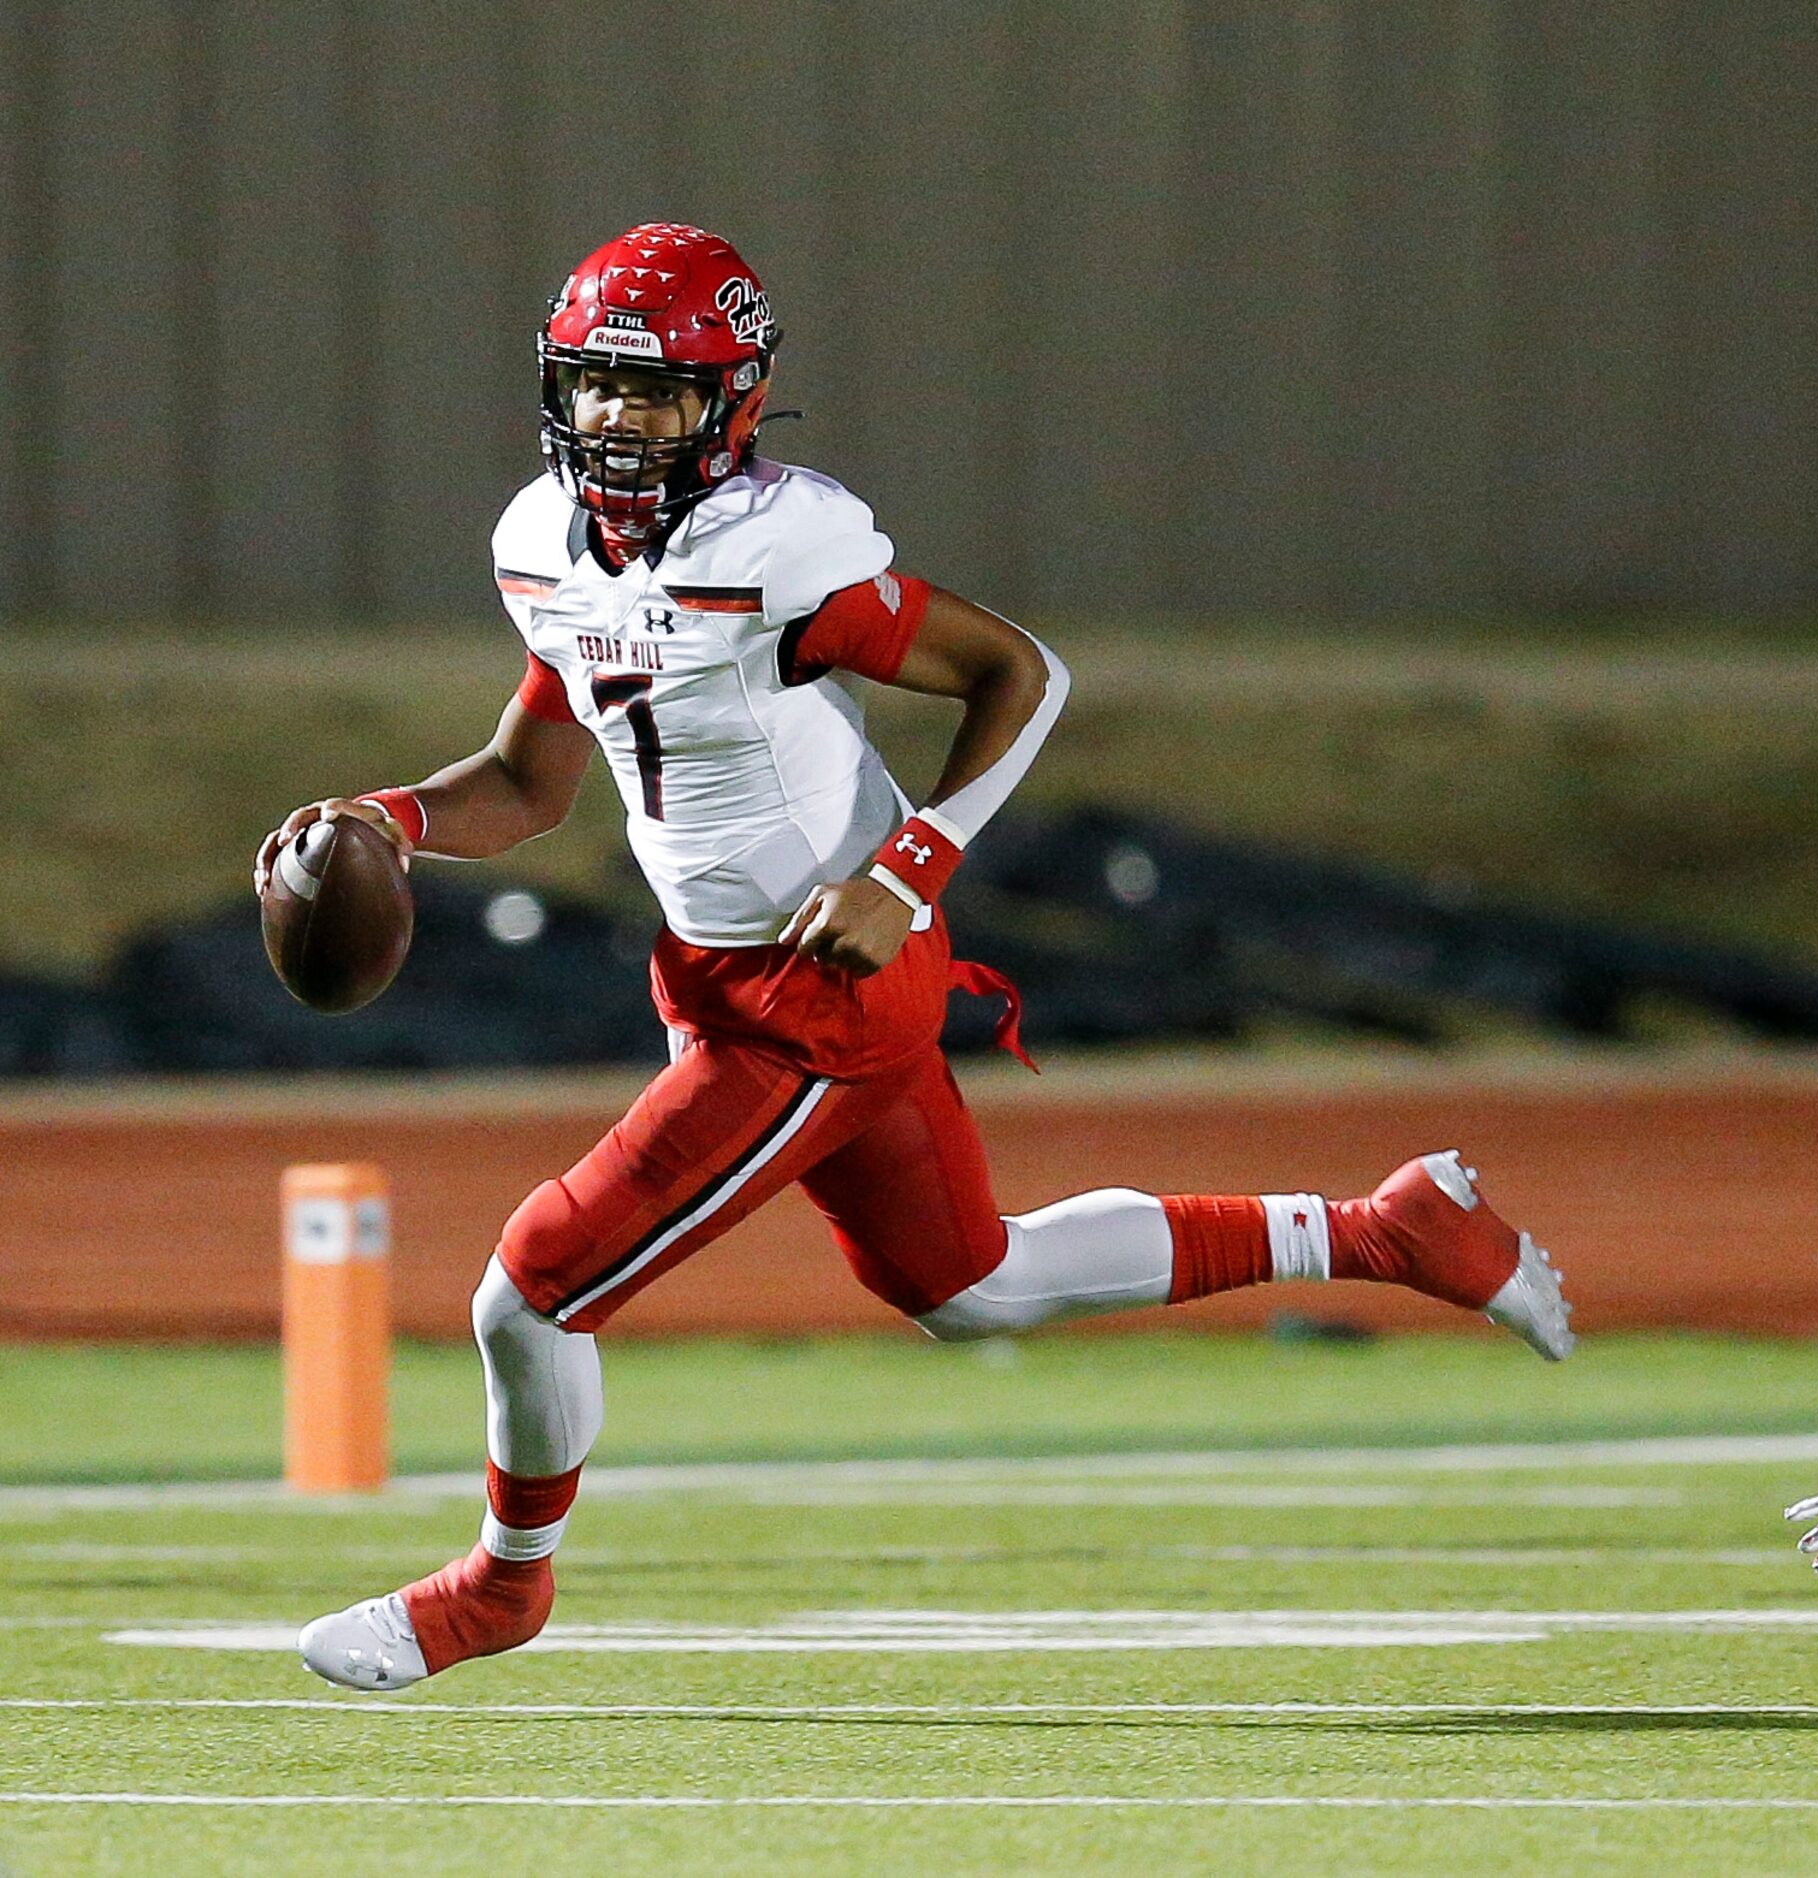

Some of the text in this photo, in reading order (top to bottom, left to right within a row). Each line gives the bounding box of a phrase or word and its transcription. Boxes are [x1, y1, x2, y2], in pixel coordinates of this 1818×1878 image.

[607, 313, 646, 329] TTHL
[595, 331, 651, 348] Riddell
[577, 635, 663, 670] CEDAR HILL
[591, 673, 664, 822] 7
